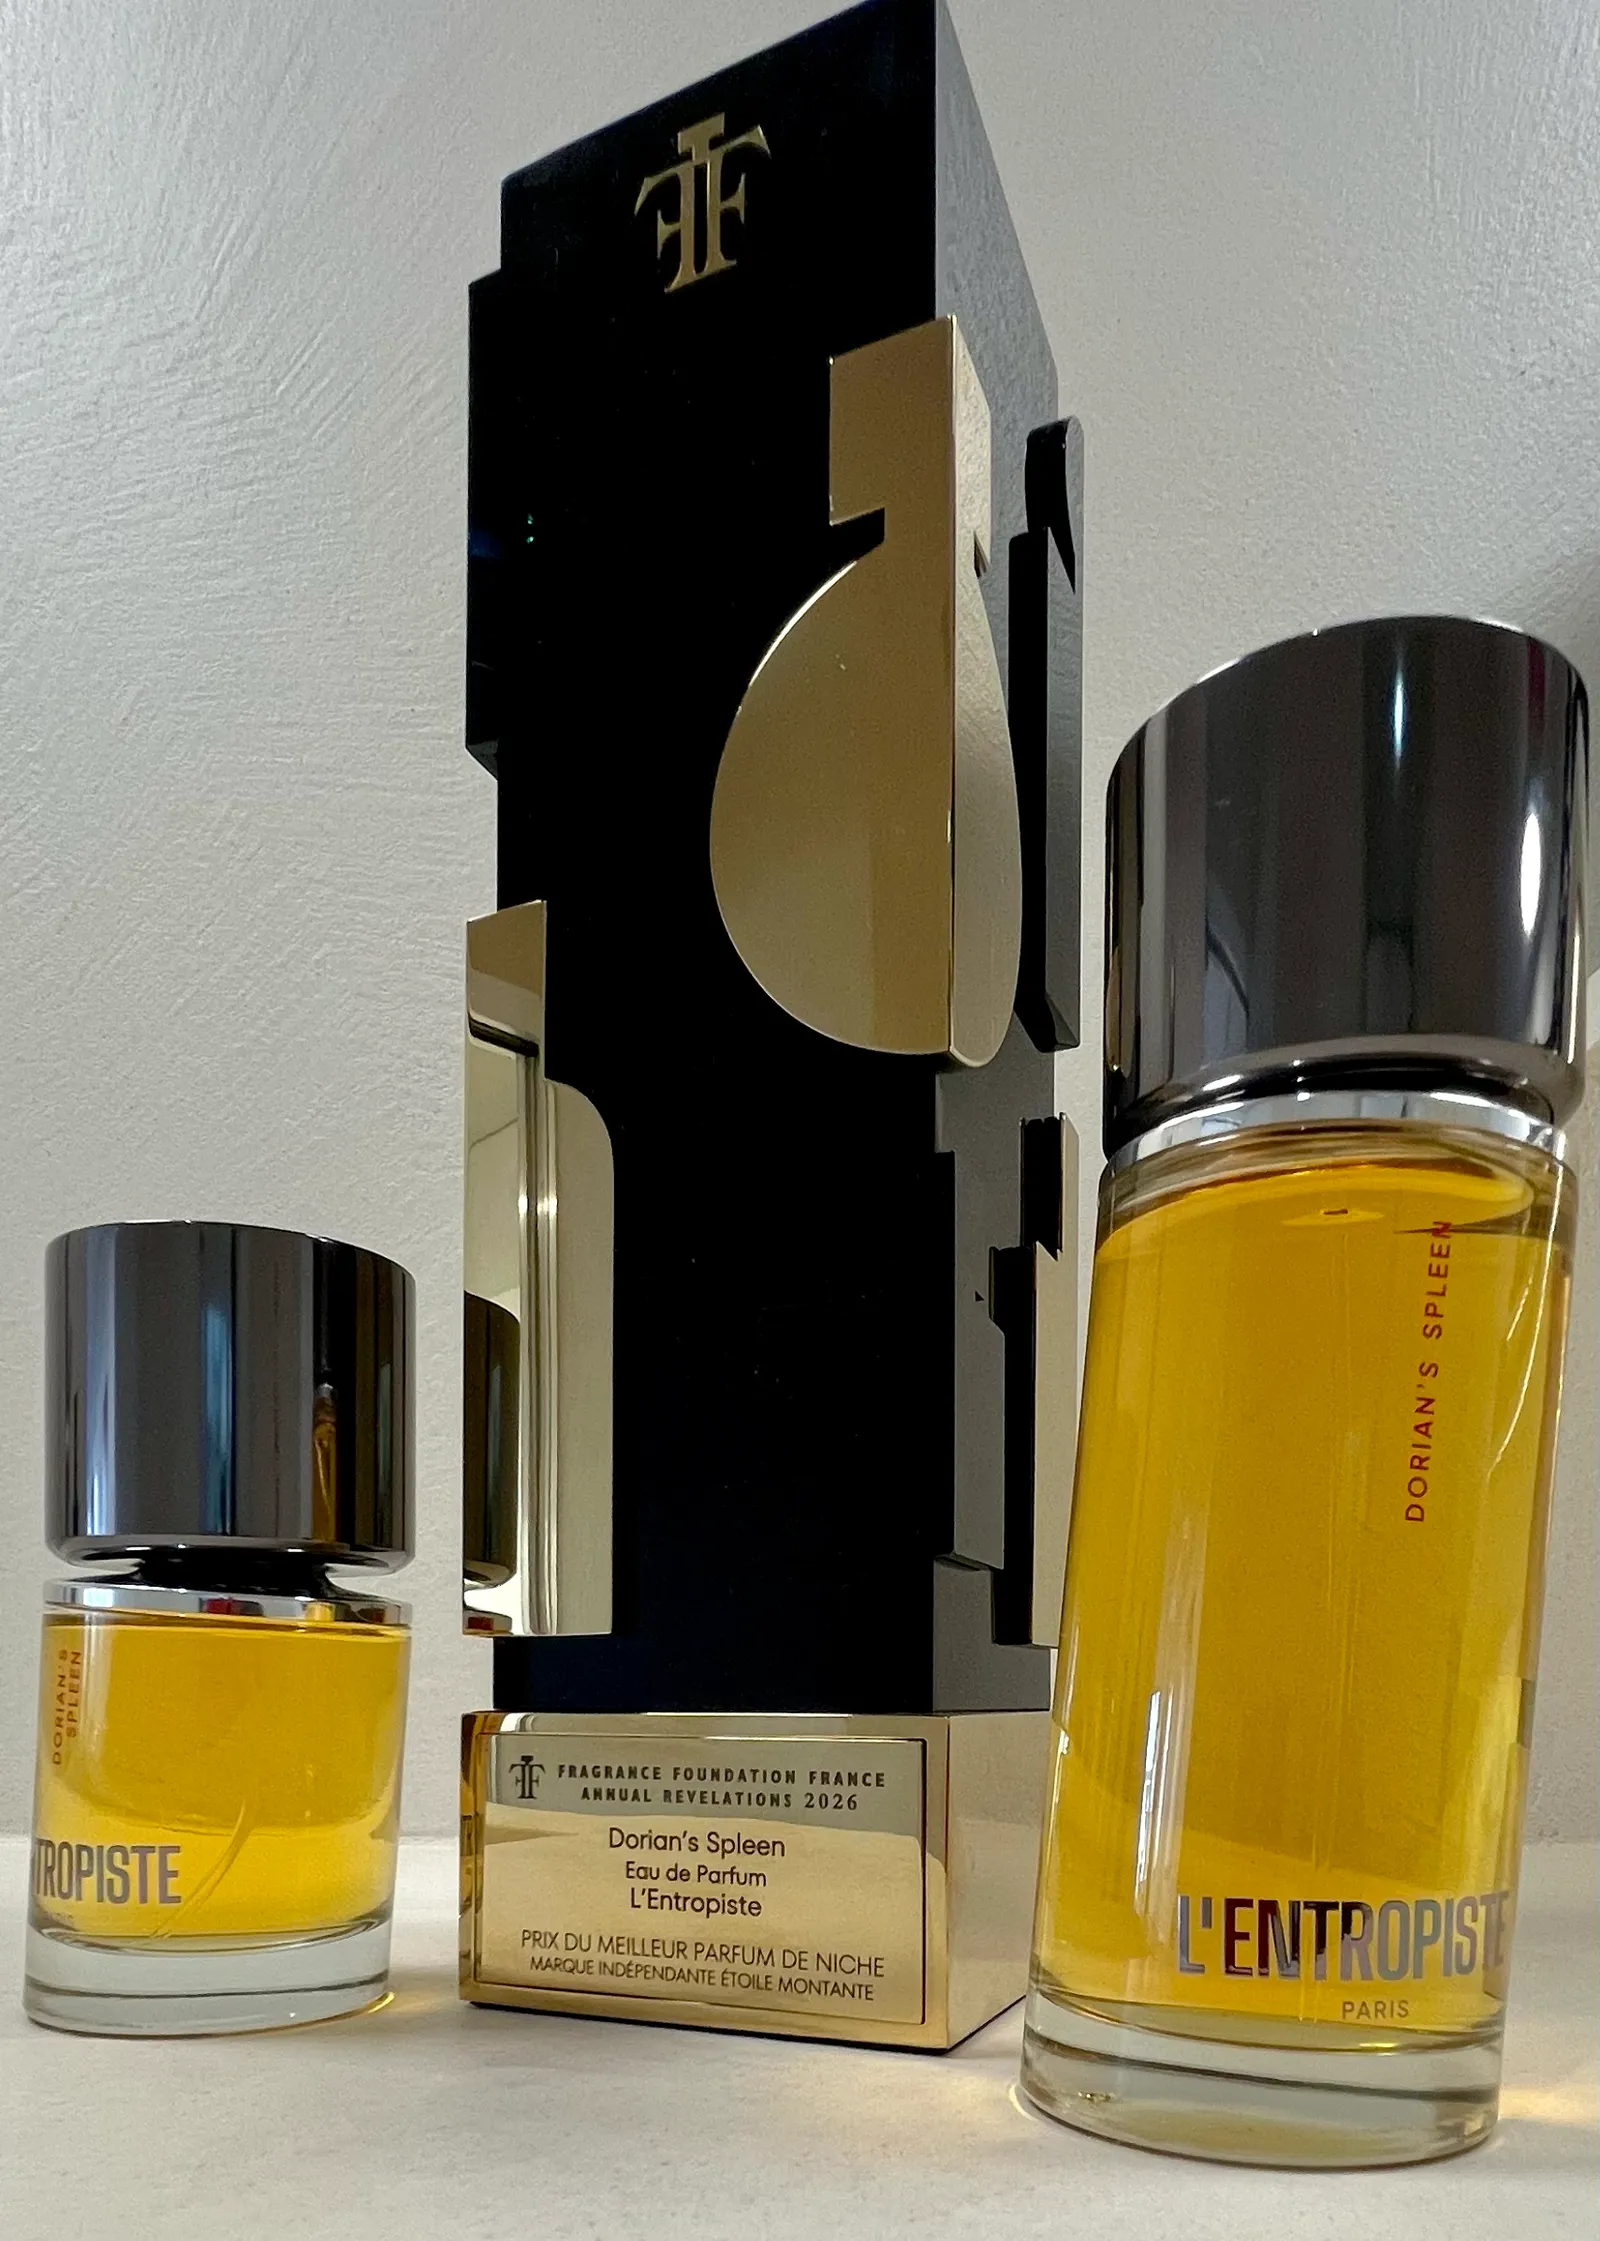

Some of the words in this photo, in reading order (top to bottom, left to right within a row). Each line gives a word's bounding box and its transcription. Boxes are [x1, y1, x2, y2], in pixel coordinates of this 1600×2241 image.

[1405, 1361, 1440, 1522] DORIAN'S
[1423, 1220, 1452, 1340] SPLEEN
[52, 1649, 68, 1765] DORIAN'S
[66, 1651, 81, 1737] SPLEEN
[558, 1764, 662, 1780] FRAGRANCE
[672, 1766, 796, 1784] FOUNDATION
[809, 1771, 885, 1787] FRANCE
[581, 1787, 652, 1802] ANNUAL
[663, 1789, 792, 1808] REVELATIONS
[804, 1792, 858, 1810] 2026
[609, 1827, 699, 1852] Dorian's
[706, 1831, 786, 1859] Spleen
[626, 1861, 660, 1880] Eau
[666, 1863, 690, 1882] de
[697, 1865, 767, 1887] Parfum
[631, 1887, 762, 1919] L'Entropiste
[521, 1929, 560, 1950] PRIX
[565, 1932, 592, 1953] DU
[597, 1935, 688, 1960] MEILLEUR
[694, 1942, 775, 1967] PARFUM
[782, 1949, 808, 1971] DE
[816, 1953, 885, 1978] NICHE
[530, 1956, 594, 1975] MARQUE
[598, 1960, 716, 1986] INDÉPENDANTE
[721, 1968, 772, 1991] ÉTOILE
[778, 1976, 874, 2001] MONTANTE
[1341, 1999, 1410, 2020] PARIS
